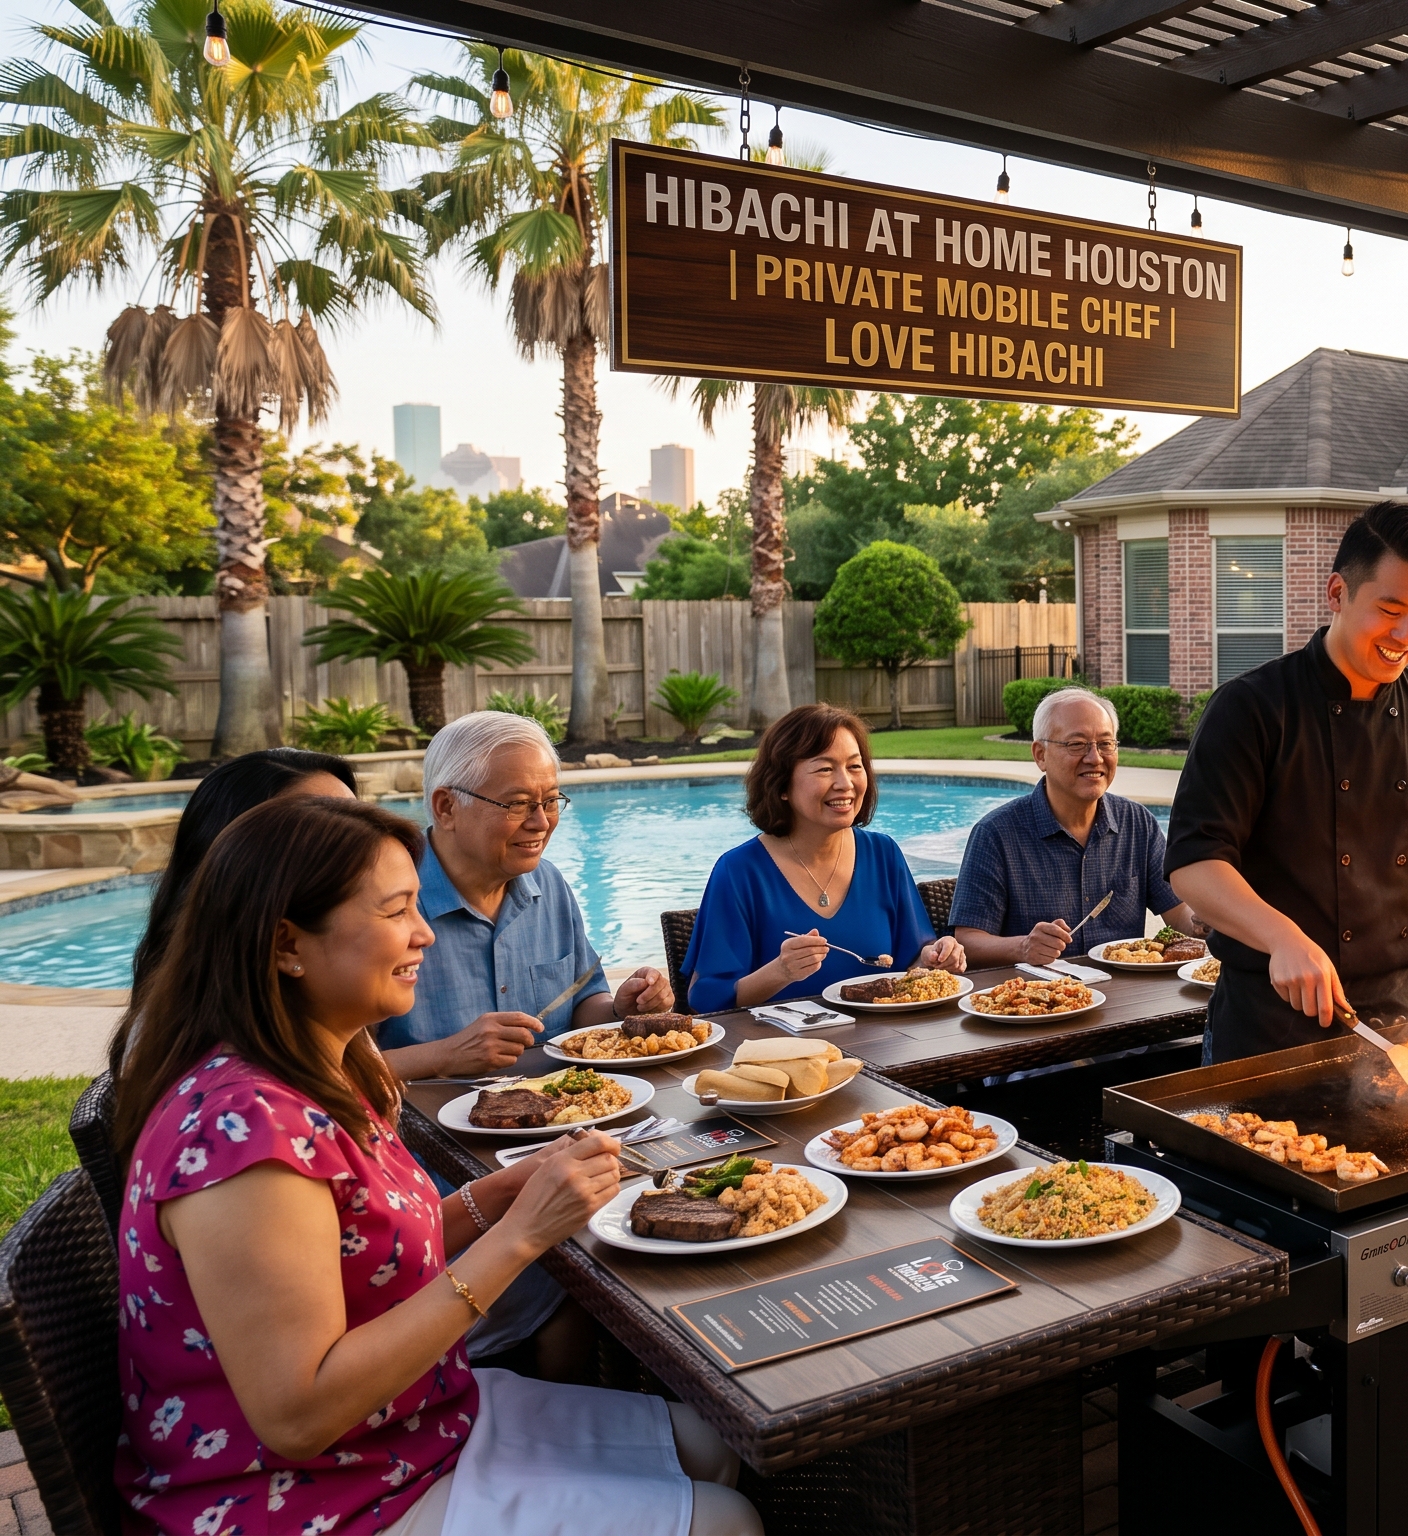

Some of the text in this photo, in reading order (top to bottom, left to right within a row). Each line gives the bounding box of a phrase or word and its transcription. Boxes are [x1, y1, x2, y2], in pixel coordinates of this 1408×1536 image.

[645, 172, 1227, 303] HIBACHI AT HOME HOUSTON
[756, 253, 924, 314] PRIVATE
[936, 277, 1069, 332] MOBILE
[1080, 296, 1161, 340] CHEF
[824, 317, 1105, 388] LOVE HIBACHI
